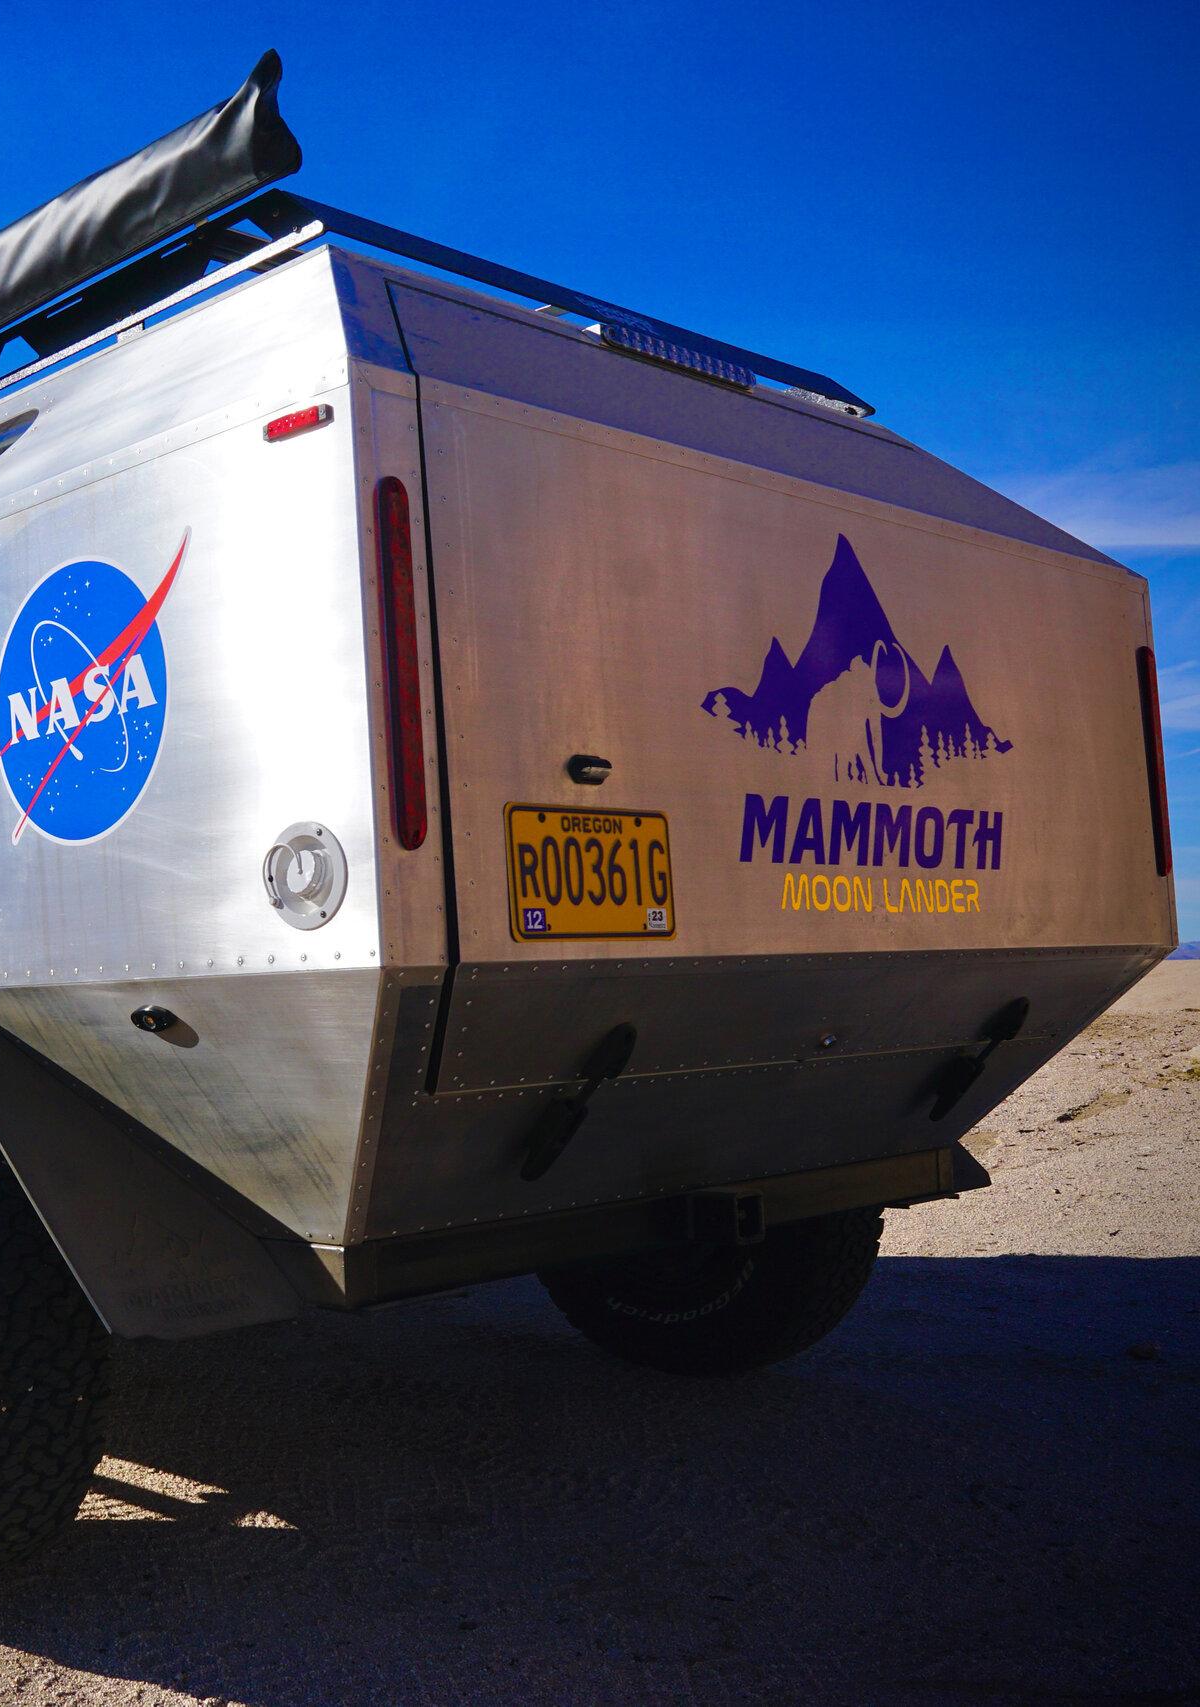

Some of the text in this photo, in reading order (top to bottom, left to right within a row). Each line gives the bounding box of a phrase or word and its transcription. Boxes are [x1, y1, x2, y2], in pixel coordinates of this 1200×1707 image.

[8, 654, 158, 745] NASA
[560, 815, 623, 834] OREGON
[739, 793, 1003, 870] MAMMOTH
[517, 836, 668, 906] R00361G
[781, 872, 981, 913] MOON LANDER
[526, 910, 543, 929] 12
[651, 910, 664, 922] 23
